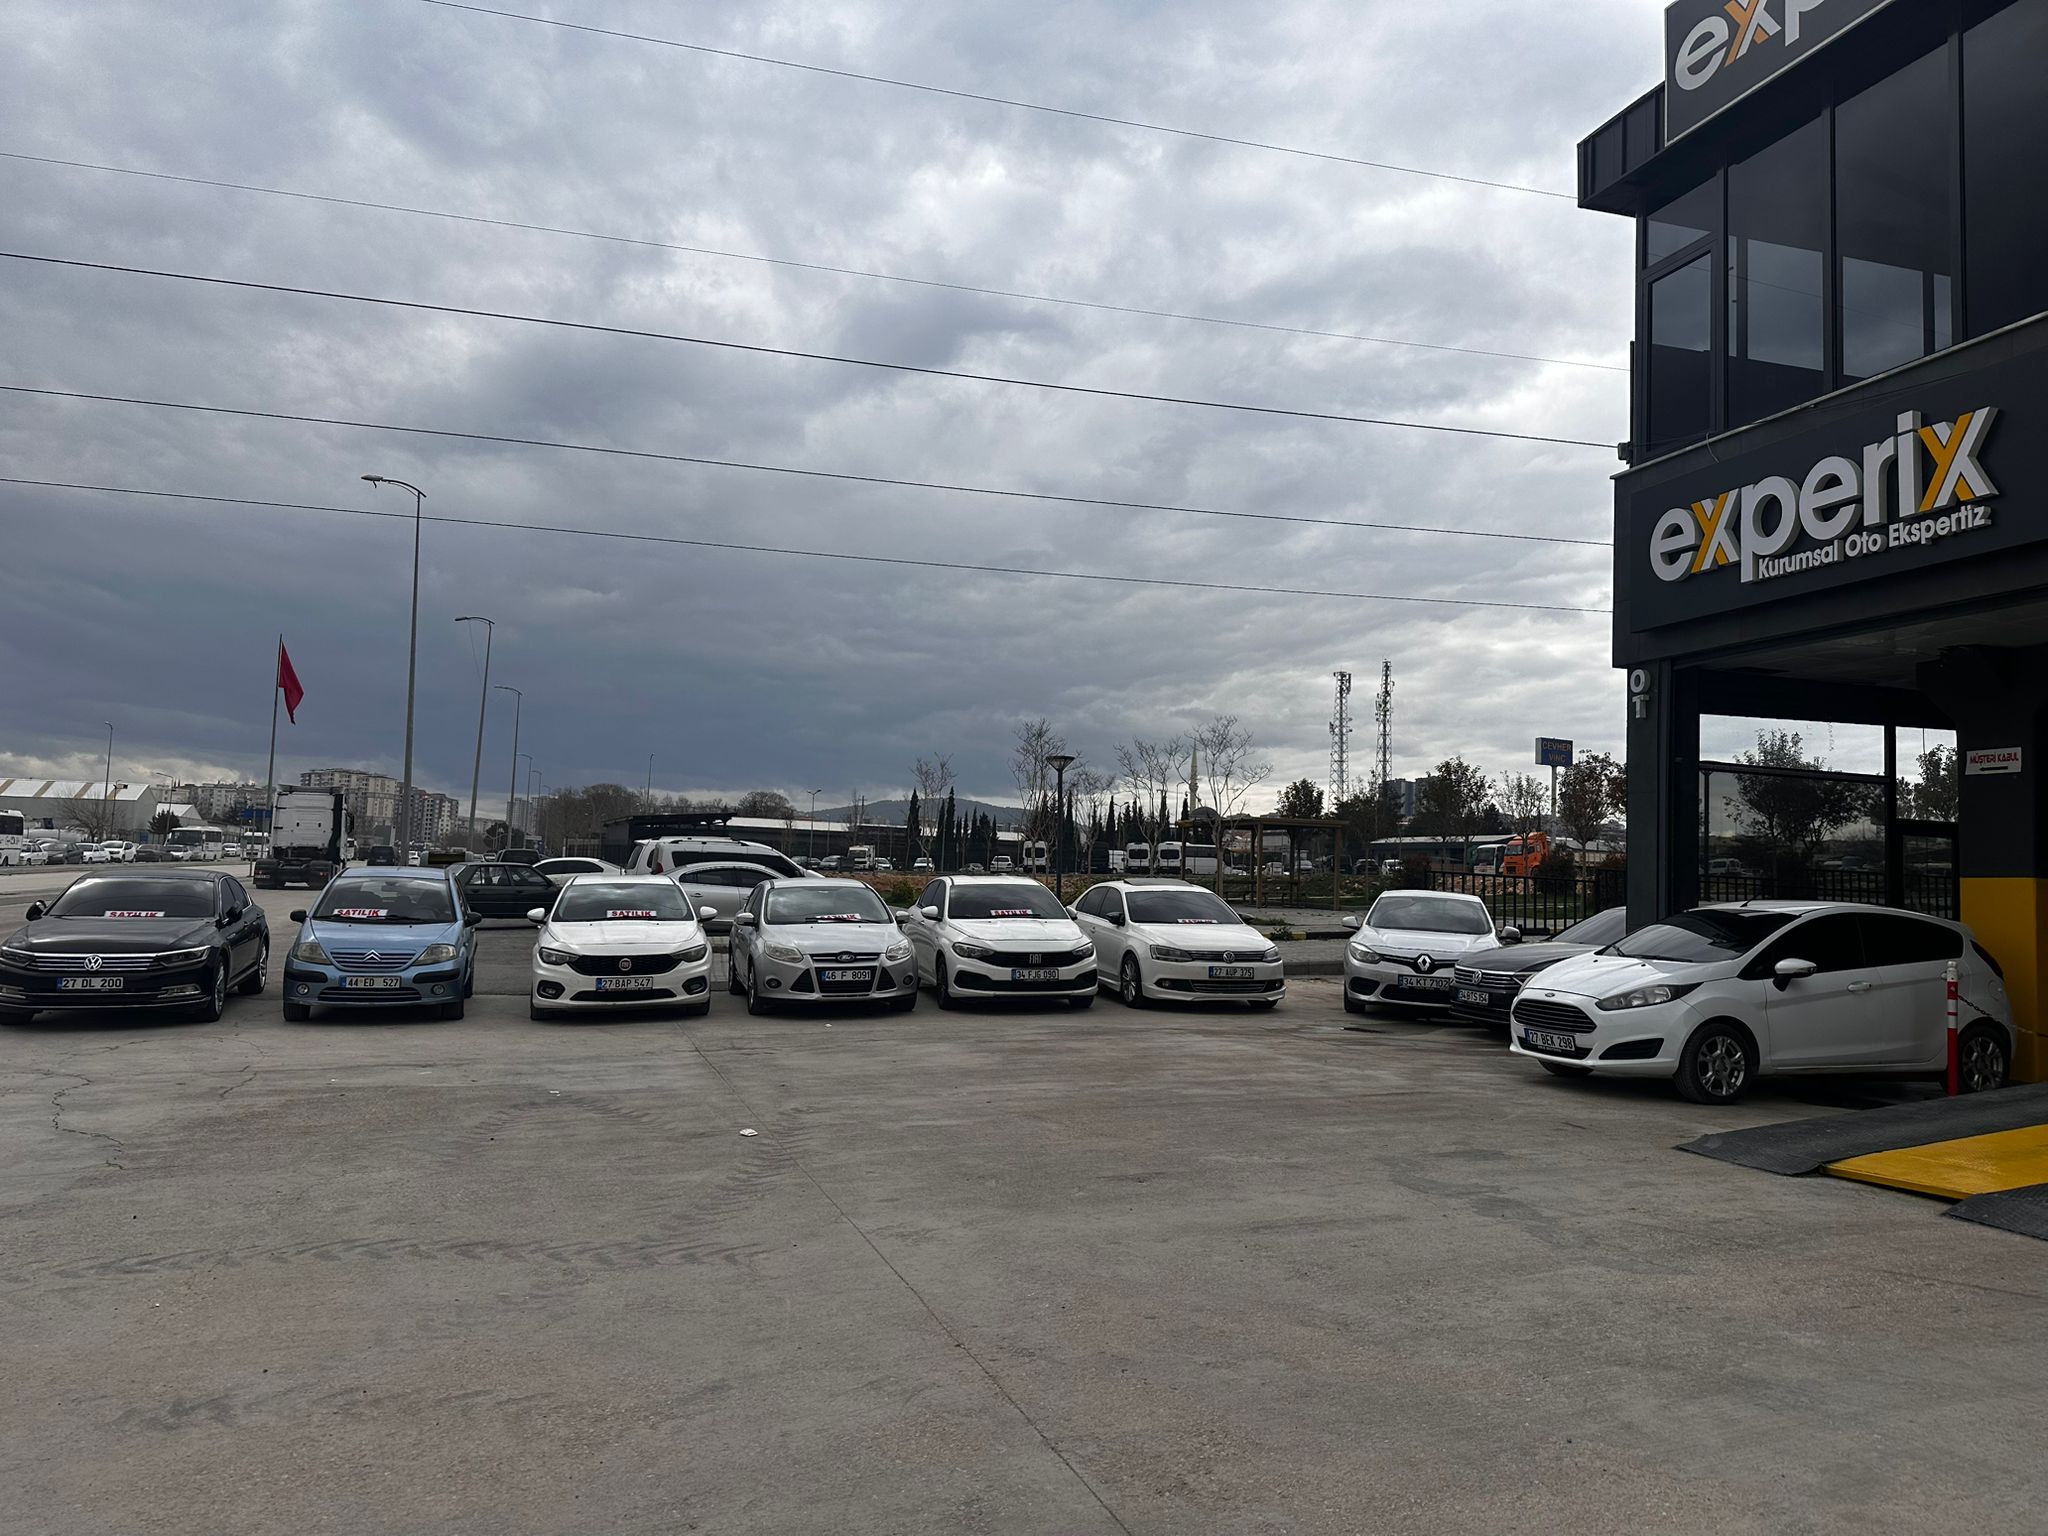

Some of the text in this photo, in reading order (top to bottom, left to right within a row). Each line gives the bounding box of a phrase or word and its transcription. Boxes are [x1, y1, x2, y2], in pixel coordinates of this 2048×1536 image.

[1650, 405, 1999, 584] experix
[1757, 503, 1990, 579] Kurumsal Oto Ekspertiz
[1542, 741, 1572, 752] CEVHER
[1996, 752, 2019, 763] KABUL
[1029, 953, 1042, 964] FIAT
[826, 971, 870, 980] 46 F 8091
[1016, 971, 1026, 979] 34
[63, 978, 122, 988] 27 DL 200
[347, 978, 399, 987] 44 ED 527
[602, 978, 651, 988] 27 BAP 547
[1403, 977, 1449, 988] 34 KT 7102
[1529, 1031, 1538, 1043] 27
[1541, 1033, 1556, 1047] BEK
[1557, 1036, 1573, 1049] 298
